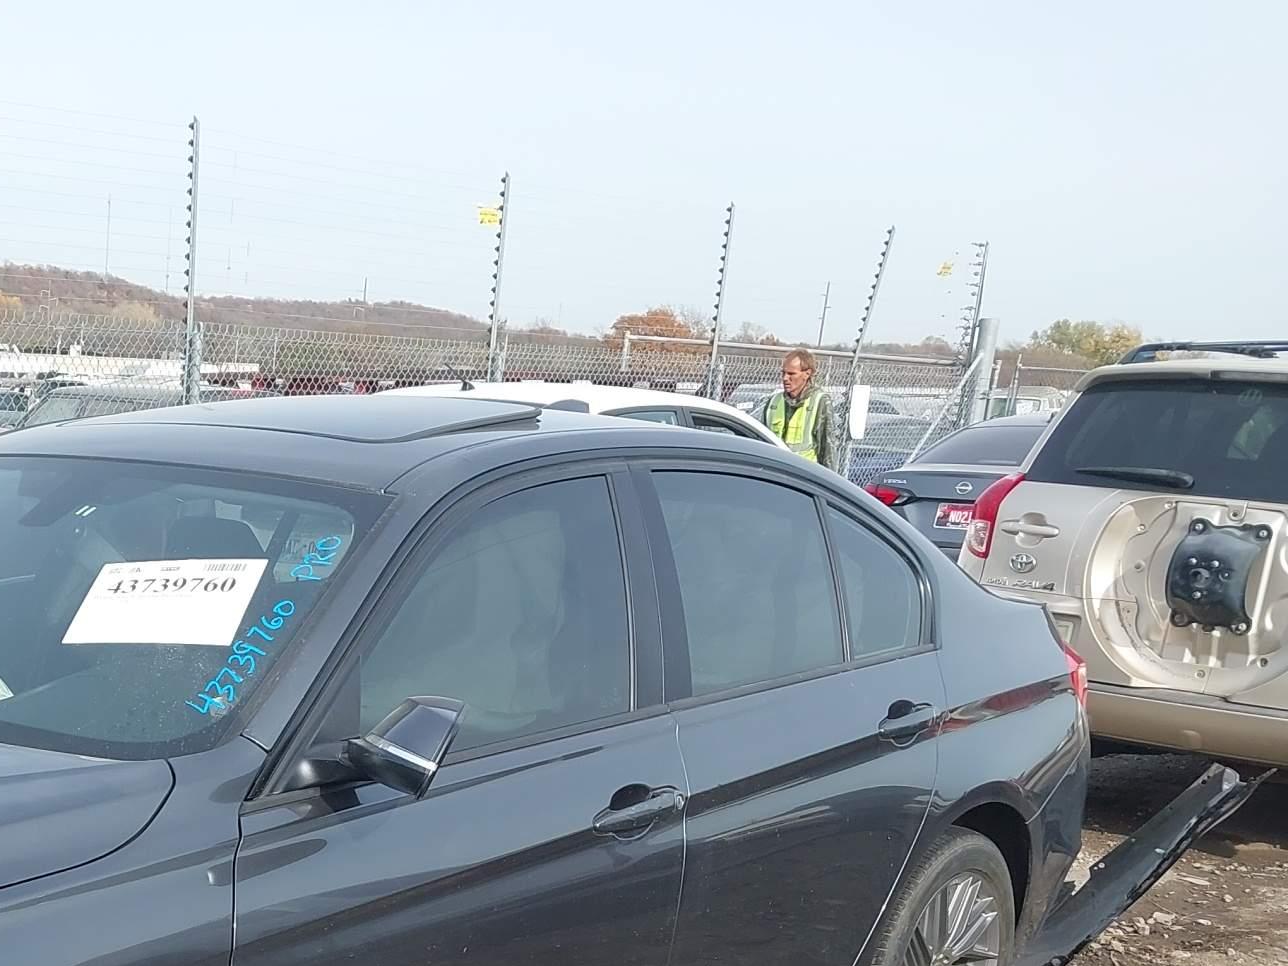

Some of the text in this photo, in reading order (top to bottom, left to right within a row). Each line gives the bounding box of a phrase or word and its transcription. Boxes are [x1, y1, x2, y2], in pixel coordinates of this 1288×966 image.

[290, 535, 342, 581] PRO
[106, 576, 237, 594] 43739760
[184, 599, 296, 714] 43739760
